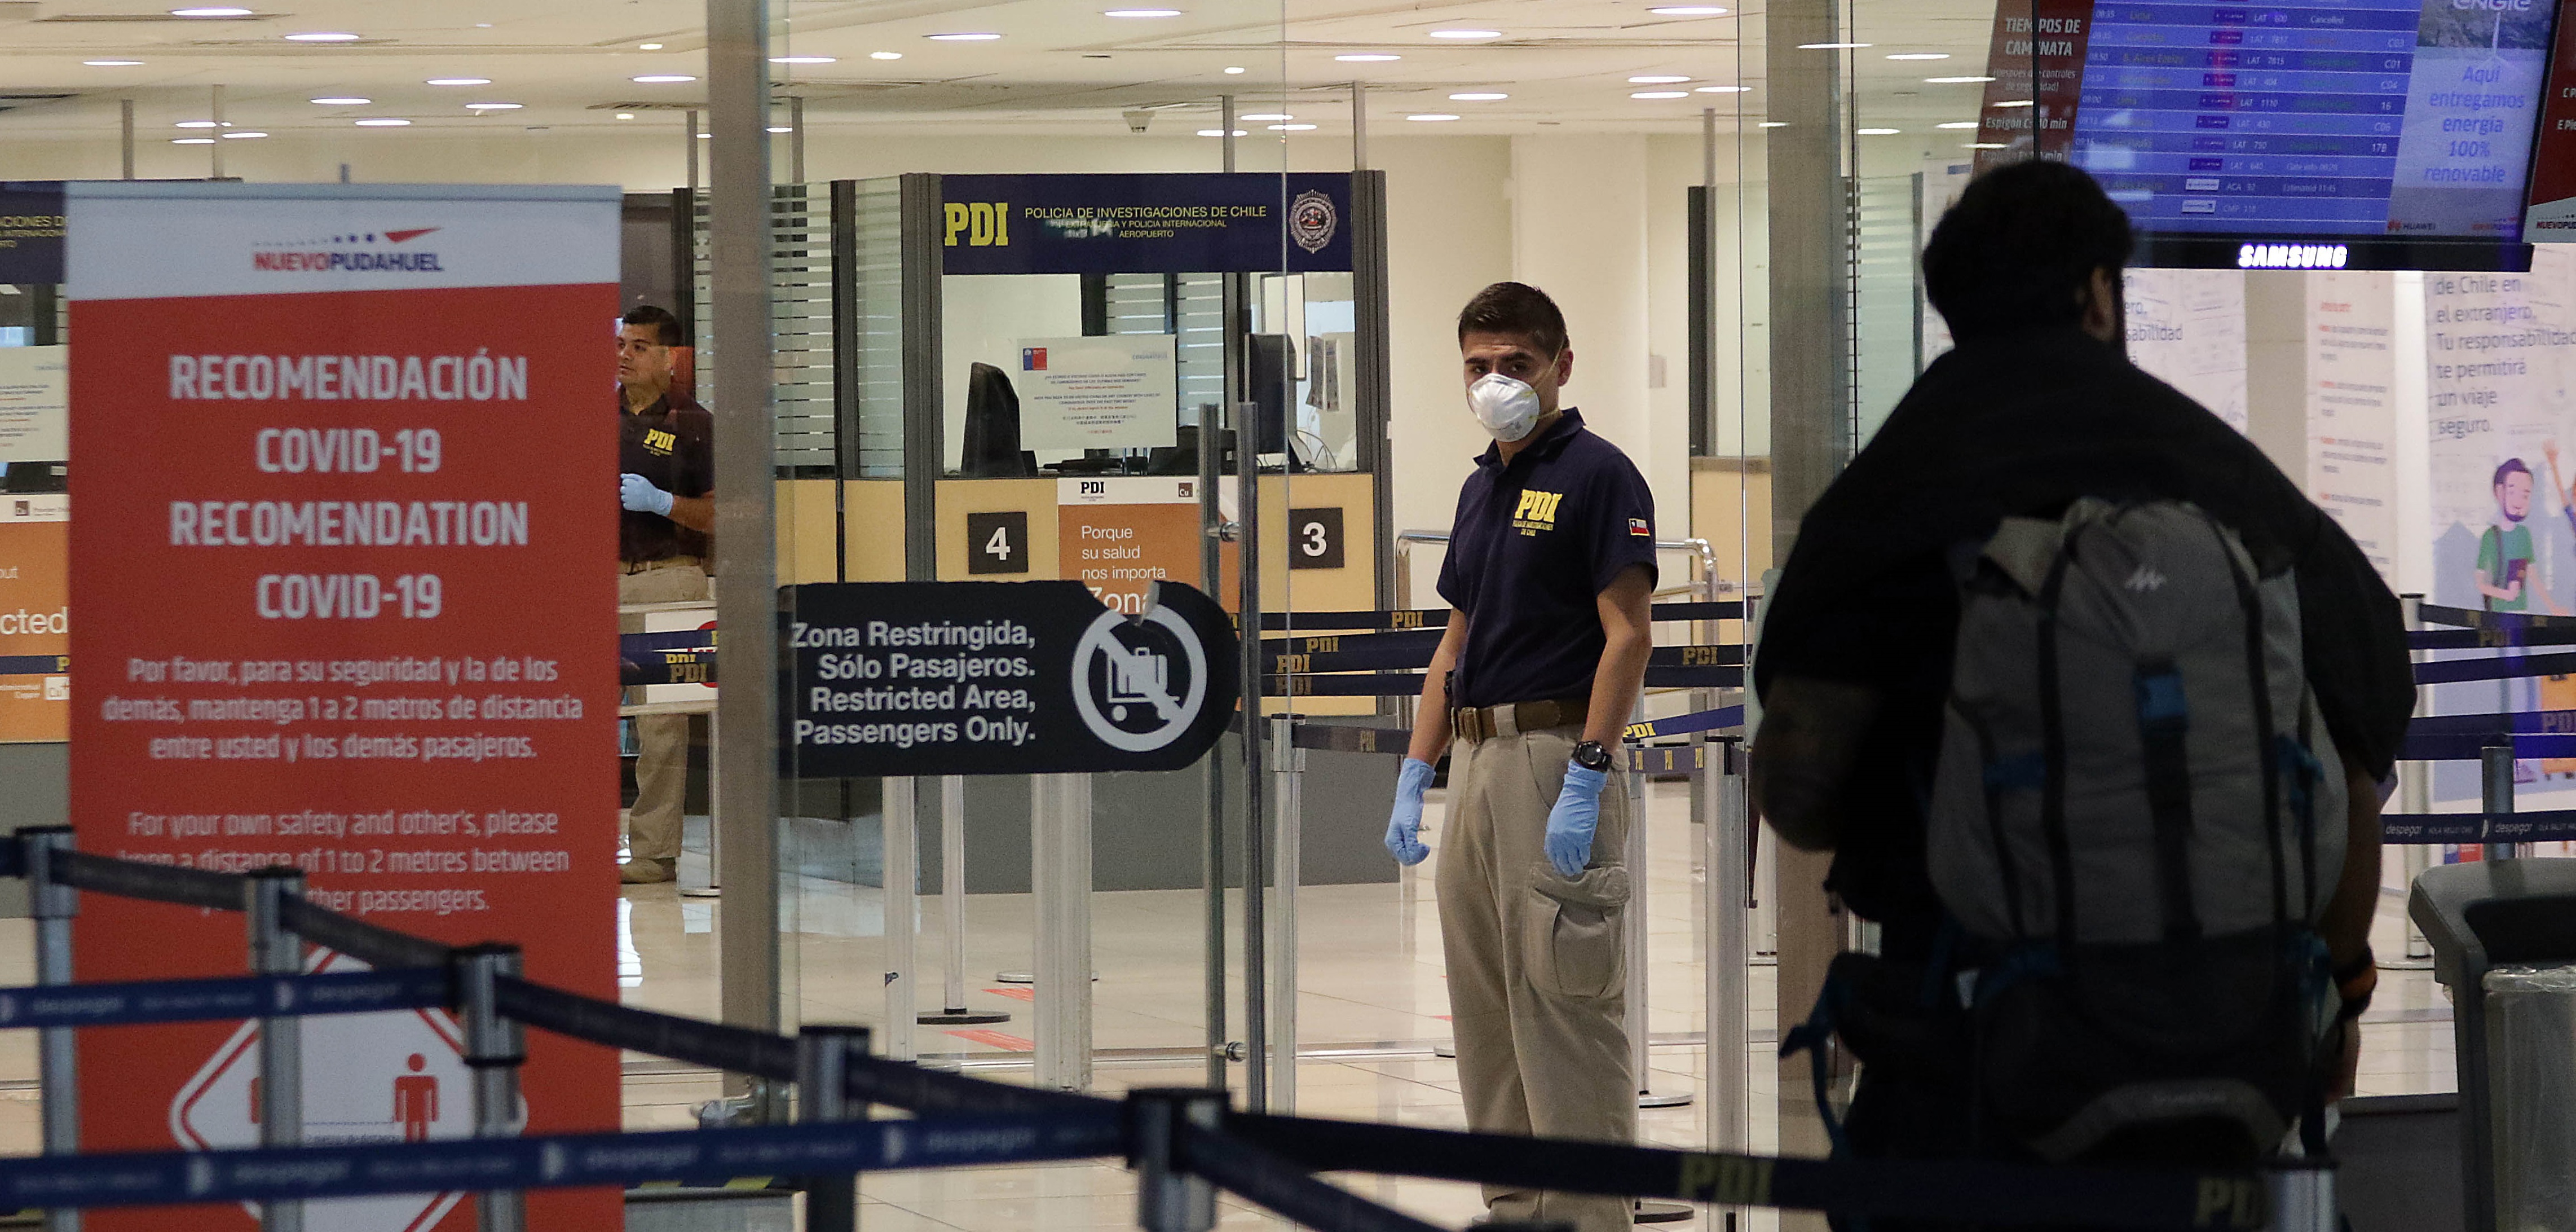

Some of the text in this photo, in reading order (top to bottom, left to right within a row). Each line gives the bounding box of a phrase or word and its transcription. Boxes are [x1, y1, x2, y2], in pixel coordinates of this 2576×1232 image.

[2065, 19, 2081, 33] DE
[2381, 102, 2392, 110] 16
[2429, 93, 2525, 111] entregamos
[2050, 119, 2067, 129] min
[2443, 117, 2504, 135] energía
[2449, 141, 2490, 157] 100%
[2424, 167, 2506, 182] renovable
[1025, 206, 1267, 218] POLICIA DE INVESTIGACIONES DE CHILE
[944, 202, 1009, 247] PDI
[1163, 219, 1227, 228] INTERNACIONAL
[1119, 230, 1174, 239] AEROPUERTO
[253, 252, 445, 271] NUEVOPUDAHUEL
[2238, 244, 2348, 268] SAMSUNG
[2436, 275, 2521, 294] de Chile en
[2437, 305, 2451, 323] el
[2436, 332, 2454, 350] Tu
[170, 346, 528, 400] RECOMENDACIÓN
[2437, 387, 2497, 408] un viaje
[643, 428, 677, 452] PDI
[256, 428, 442, 473] COVID-19
[1080, 481, 1105, 494] PDI
[1514, 489, 1563, 523] PDI
[170, 501, 528, 547] RECOMENDATION
[1081, 525, 1133, 541] Porque
[986, 527, 1011, 560] 4
[1302, 522, 1327, 557] 3
[1082, 545, 1141, 560] su salud
[1082, 565, 1167, 582] nos importa
[256, 573, 442, 620] COVID-19
[1391, 611, 1424, 629] PDI
[791, 619, 1036, 650] Zona Restringida,
[1305, 636, 1339, 654] PDI
[1276, 654, 1311, 675] PDI
[1682, 646, 1719, 666] PDI
[127, 655, 559, 687] Por favor, para su seguridad y la de los
[670, 663, 708, 684] PDI
[818, 652, 1036, 683] Sólo Pasajeros.
[1274, 676, 1312, 696] PDI
[810, 683, 1036, 713] Restricted Area,
[103, 693, 583, 725] demás, mantenga 1 a 2 metros de distancia
[793, 714, 1036, 749] Passengers Only.
[1622, 722, 1656, 738] PDI
[148, 732, 537, 763] entre usted y los demás pasajeros.
[128, 808, 559, 841] For your own safety and other's, please
[2385, 825, 2423, 837] despegar
[2495, 822, 2533, 835] despegar
[295, 847, 322, 873] of
[323, 849, 336, 873] 1
[341, 850, 365, 873] to
[368, 848, 383, 873] 2
[387, 850, 468, 873] metres
[472, 847, 570, 873] between
[358, 890, 490, 916] passengers.
[1679, 1154, 1774, 1206] PDI
